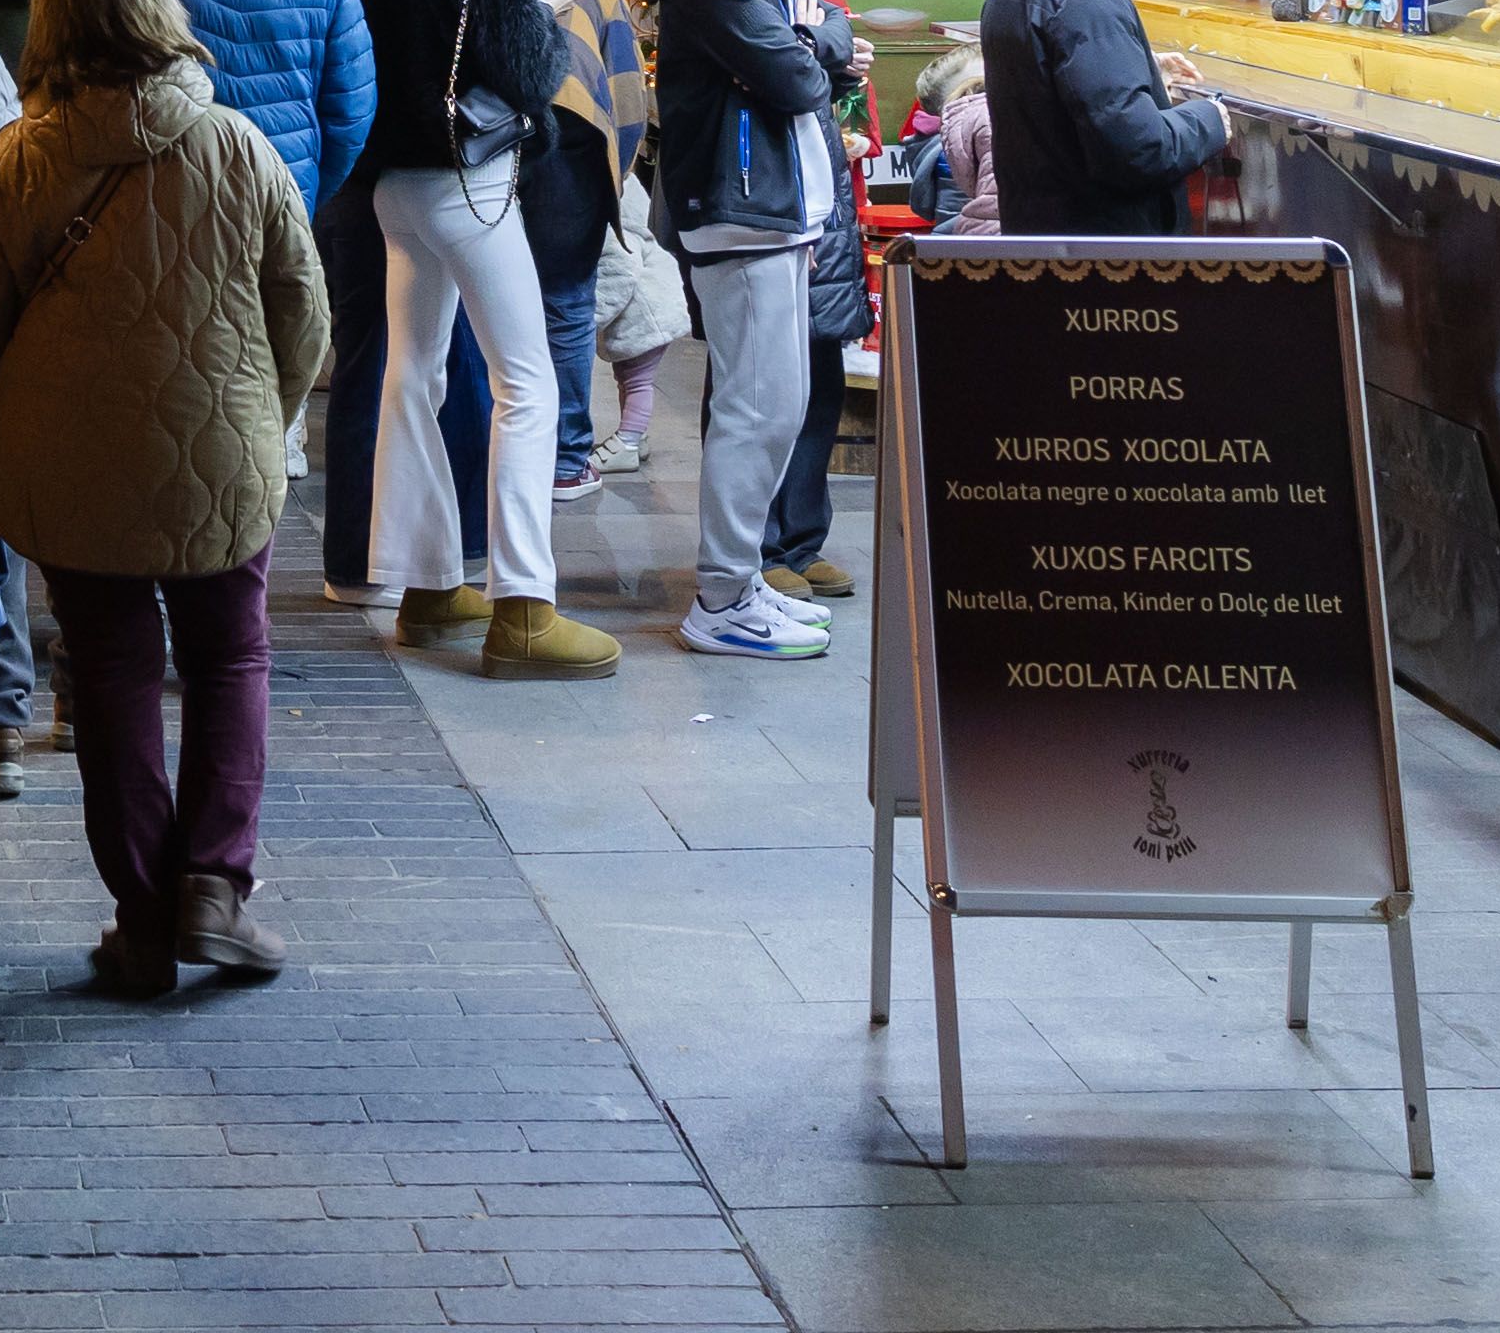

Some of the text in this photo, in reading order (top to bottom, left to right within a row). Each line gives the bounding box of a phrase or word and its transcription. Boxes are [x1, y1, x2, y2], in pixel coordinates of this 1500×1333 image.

[1065, 308, 1180, 333] XURROS
[1069, 376, 1185, 401] PORRAS
[995, 437, 1272, 463] XURROS XOCOLATA
[945, 480, 1327, 506] Xocolata negre o xocolata amb llet
[1031, 546, 1253, 572] XUXOS FARCITS
[946, 589, 1343, 618] Nutella, Crema, Kinder o Dolç de llet
[1006, 662, 1297, 691] XOCOLATA CALENTA
